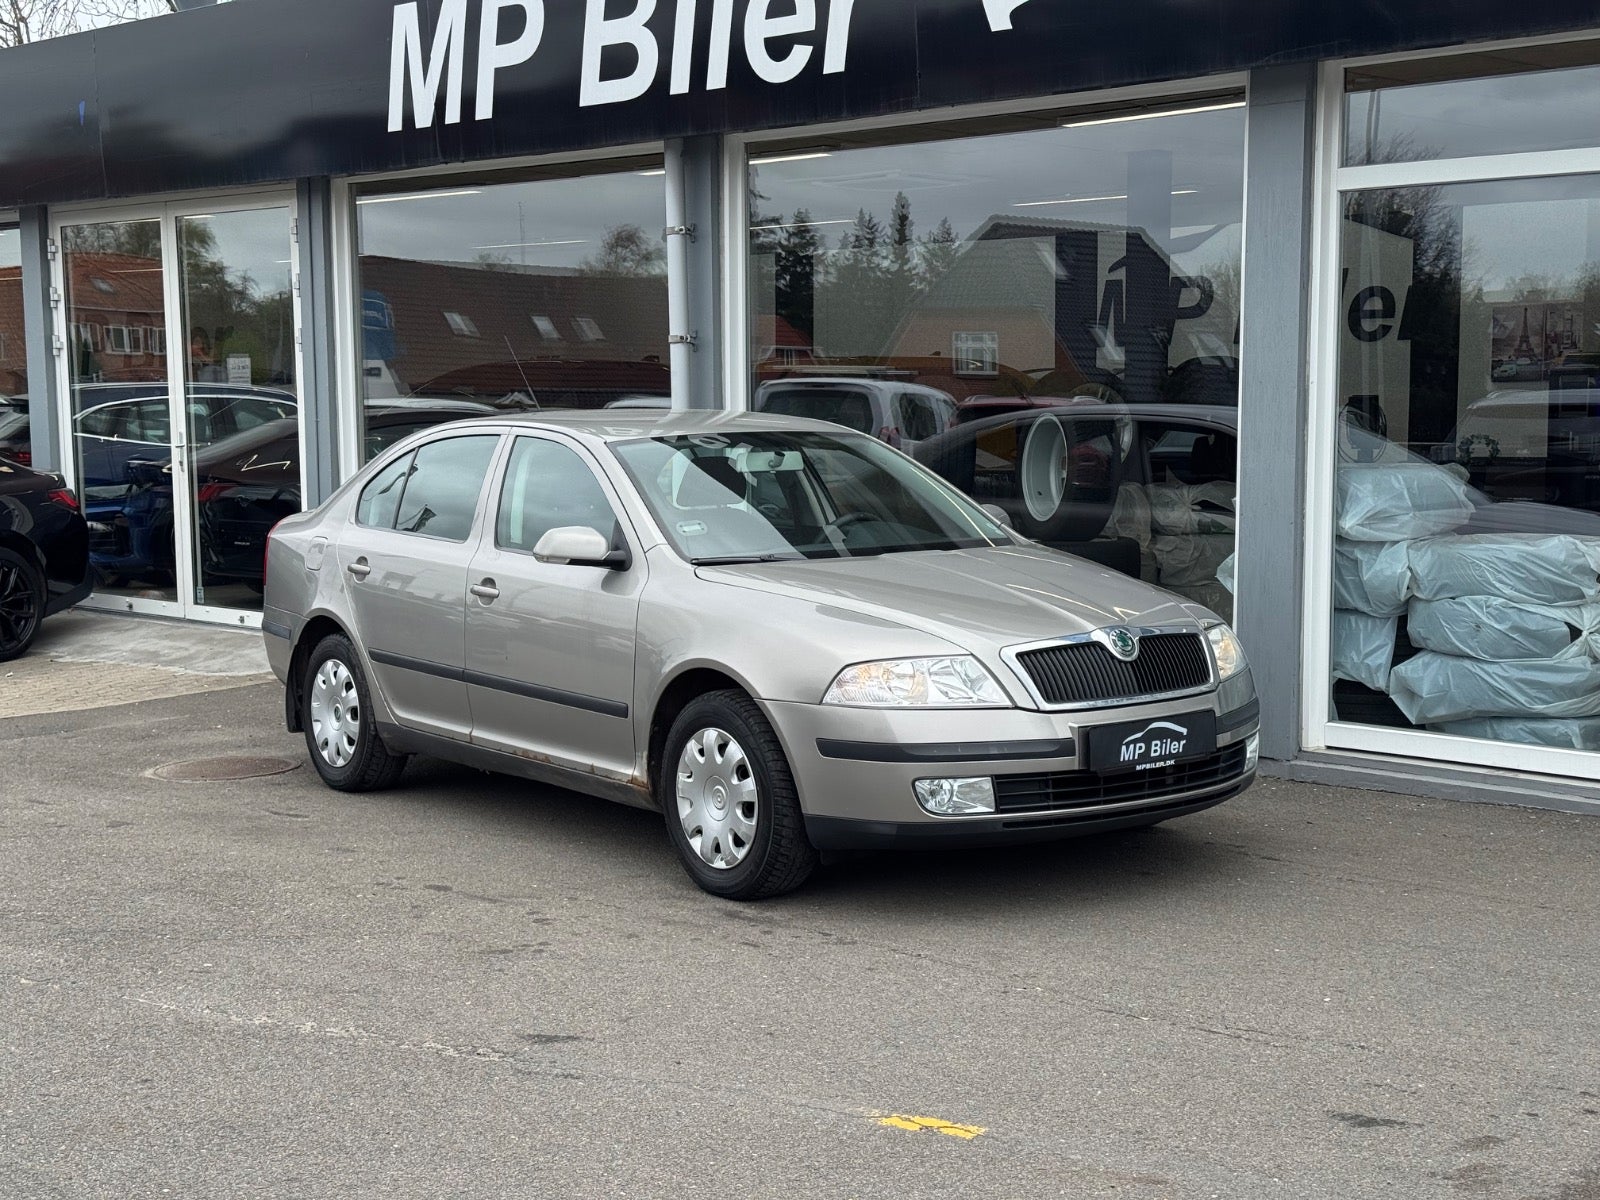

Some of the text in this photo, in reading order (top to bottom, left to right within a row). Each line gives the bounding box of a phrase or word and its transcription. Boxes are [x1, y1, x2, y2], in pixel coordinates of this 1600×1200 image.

[387, 0, 859, 133] MP Biler
[1120, 738, 1186, 762] MP Biler
[1136, 760, 1175, 771] MPBILER.DK
